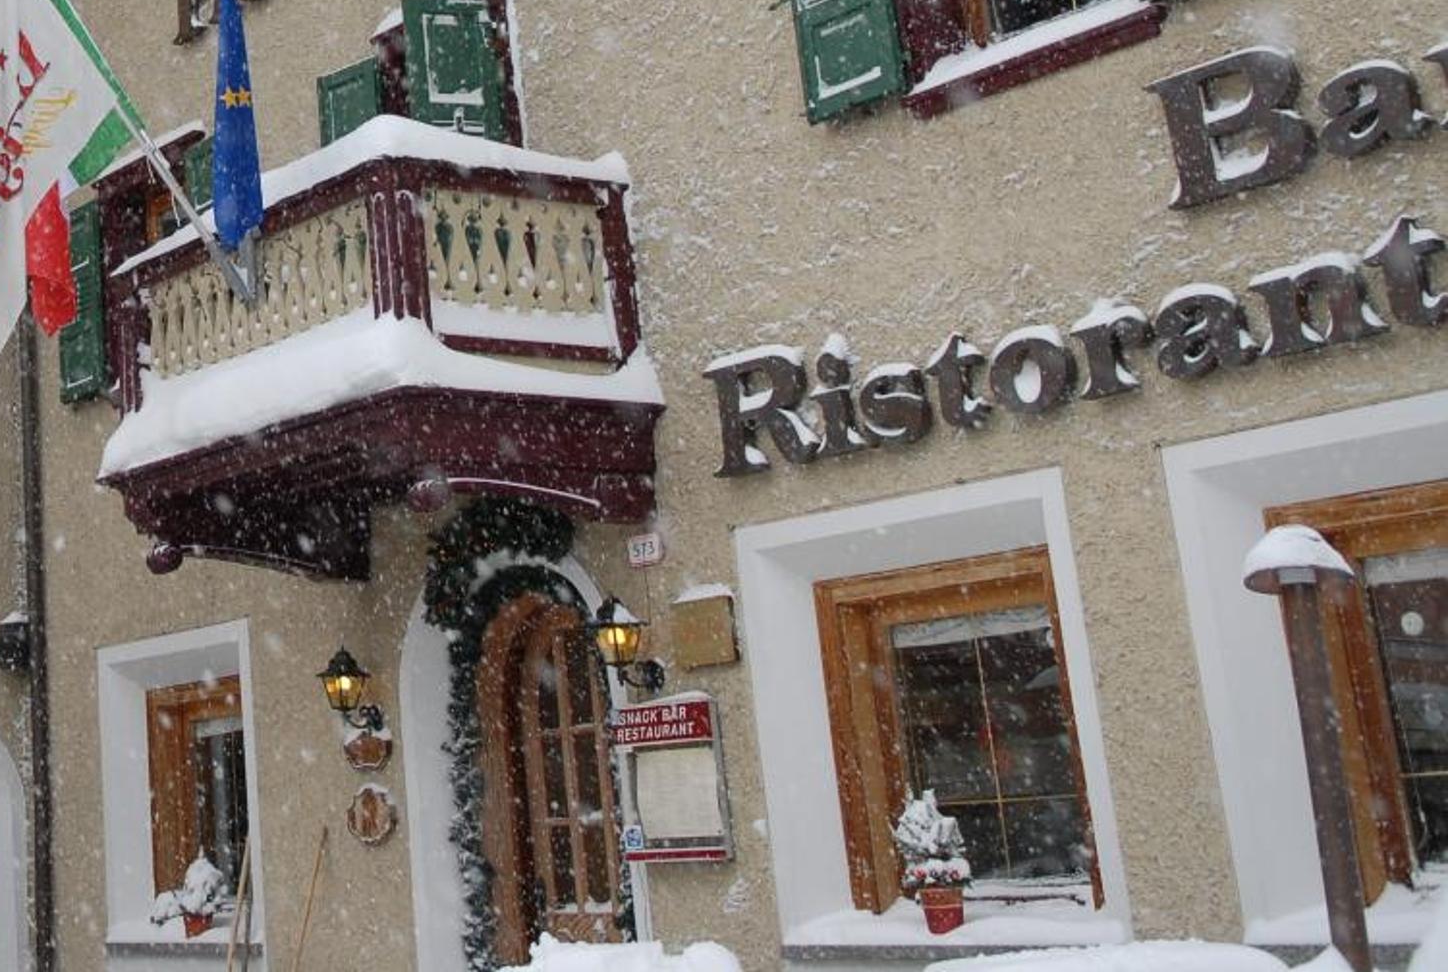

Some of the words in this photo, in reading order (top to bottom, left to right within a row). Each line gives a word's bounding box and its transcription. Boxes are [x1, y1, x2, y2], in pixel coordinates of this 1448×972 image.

[617, 709, 658, 727] SNACK
[662, 705, 687, 723] BAR
[616, 722, 695, 744] RESTAURANT
